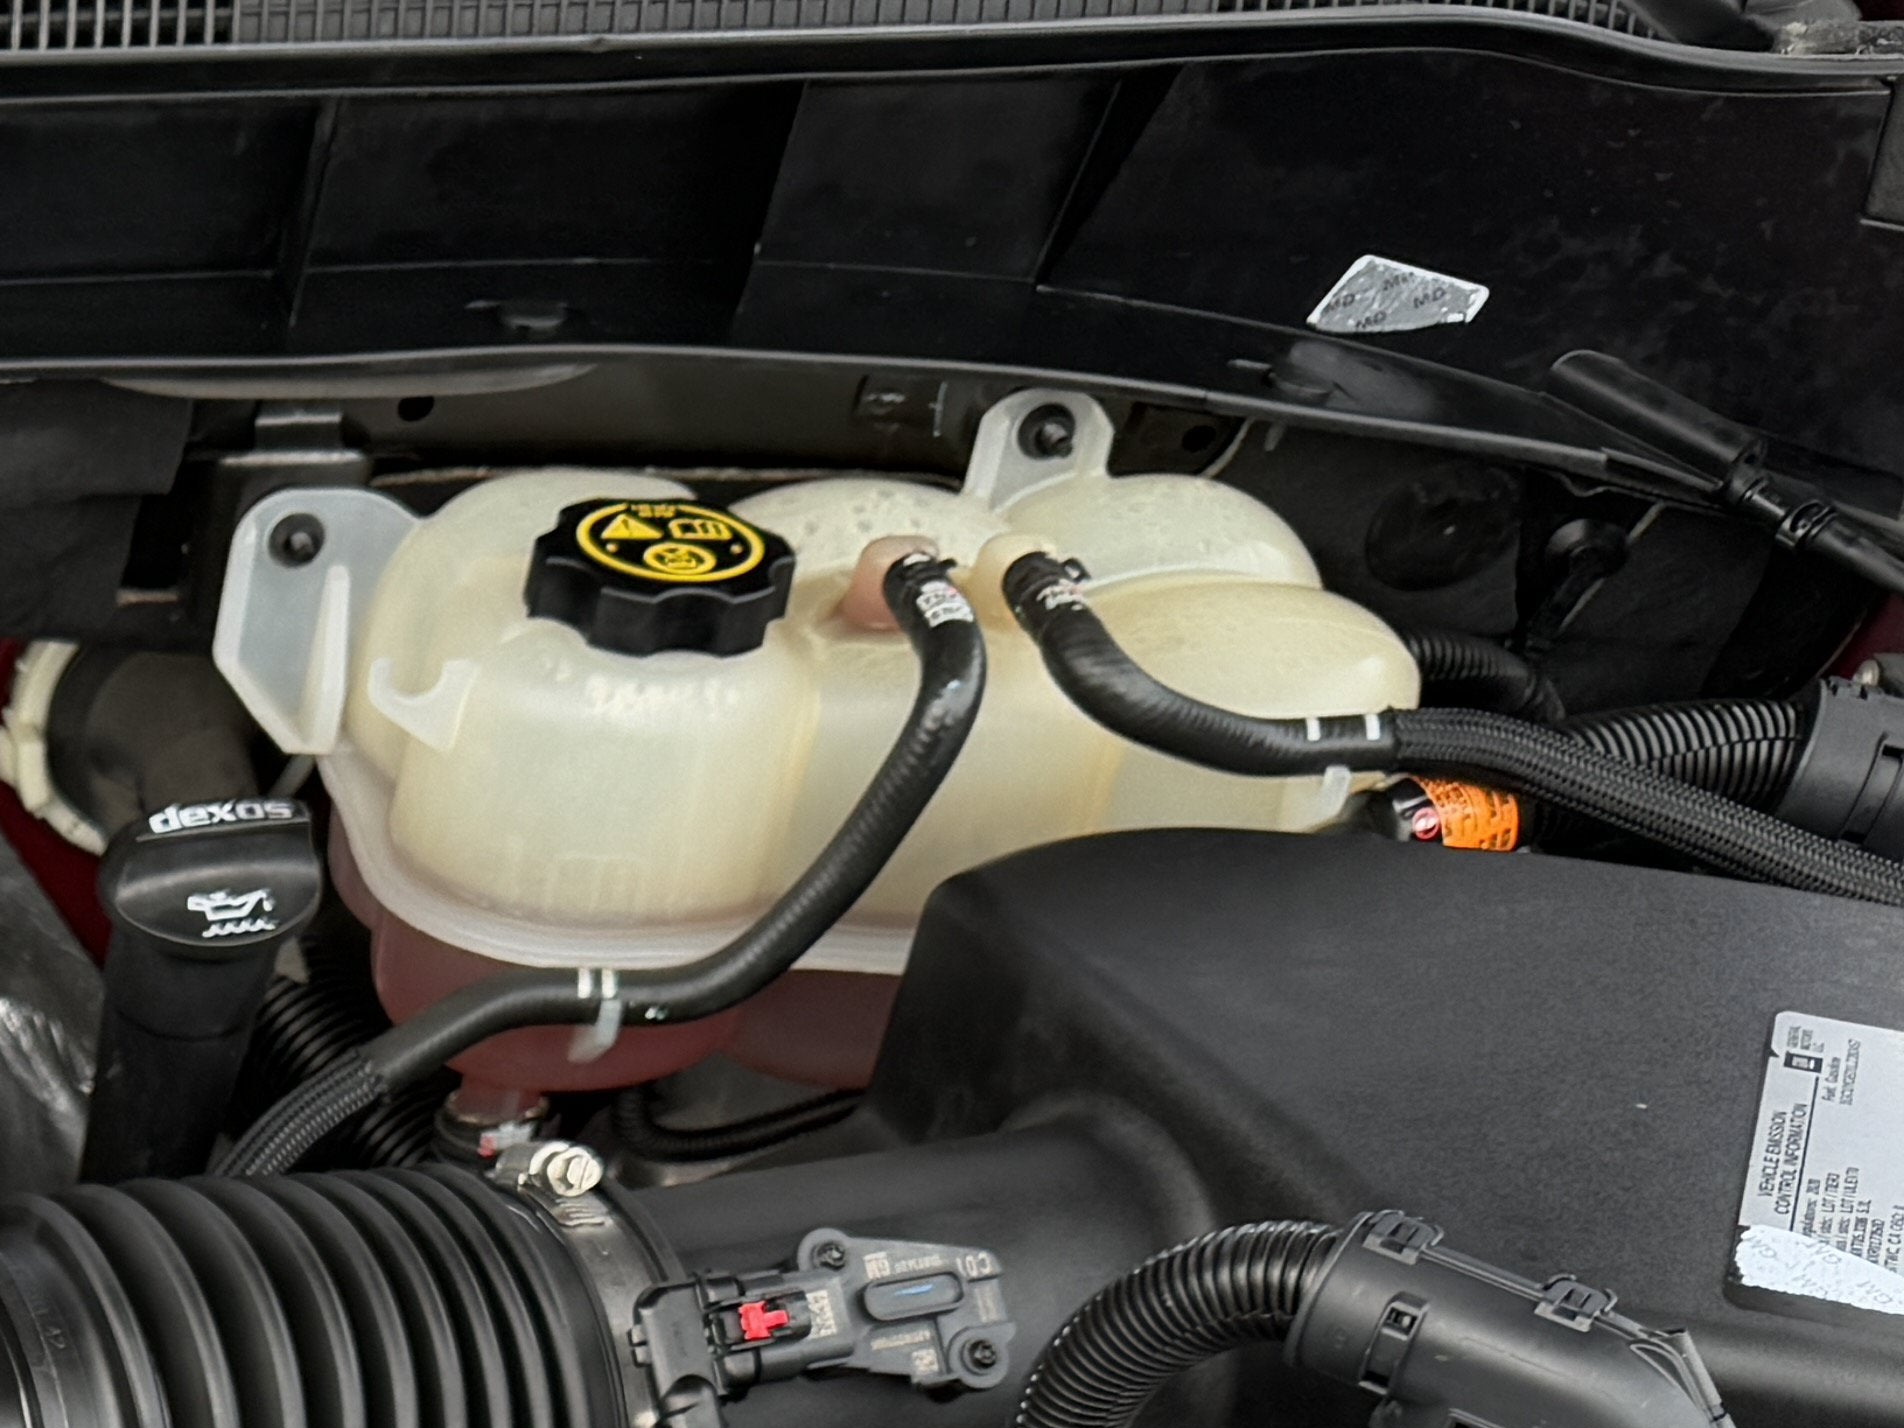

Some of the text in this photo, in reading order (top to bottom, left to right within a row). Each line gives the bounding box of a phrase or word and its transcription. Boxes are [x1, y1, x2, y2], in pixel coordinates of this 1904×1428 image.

[148, 800, 293, 834] dexos
[1758, 1111, 1787, 1197] VEHICLE EMISSION
[1774, 1103, 1807, 1215] CONTROL INFORMATION
